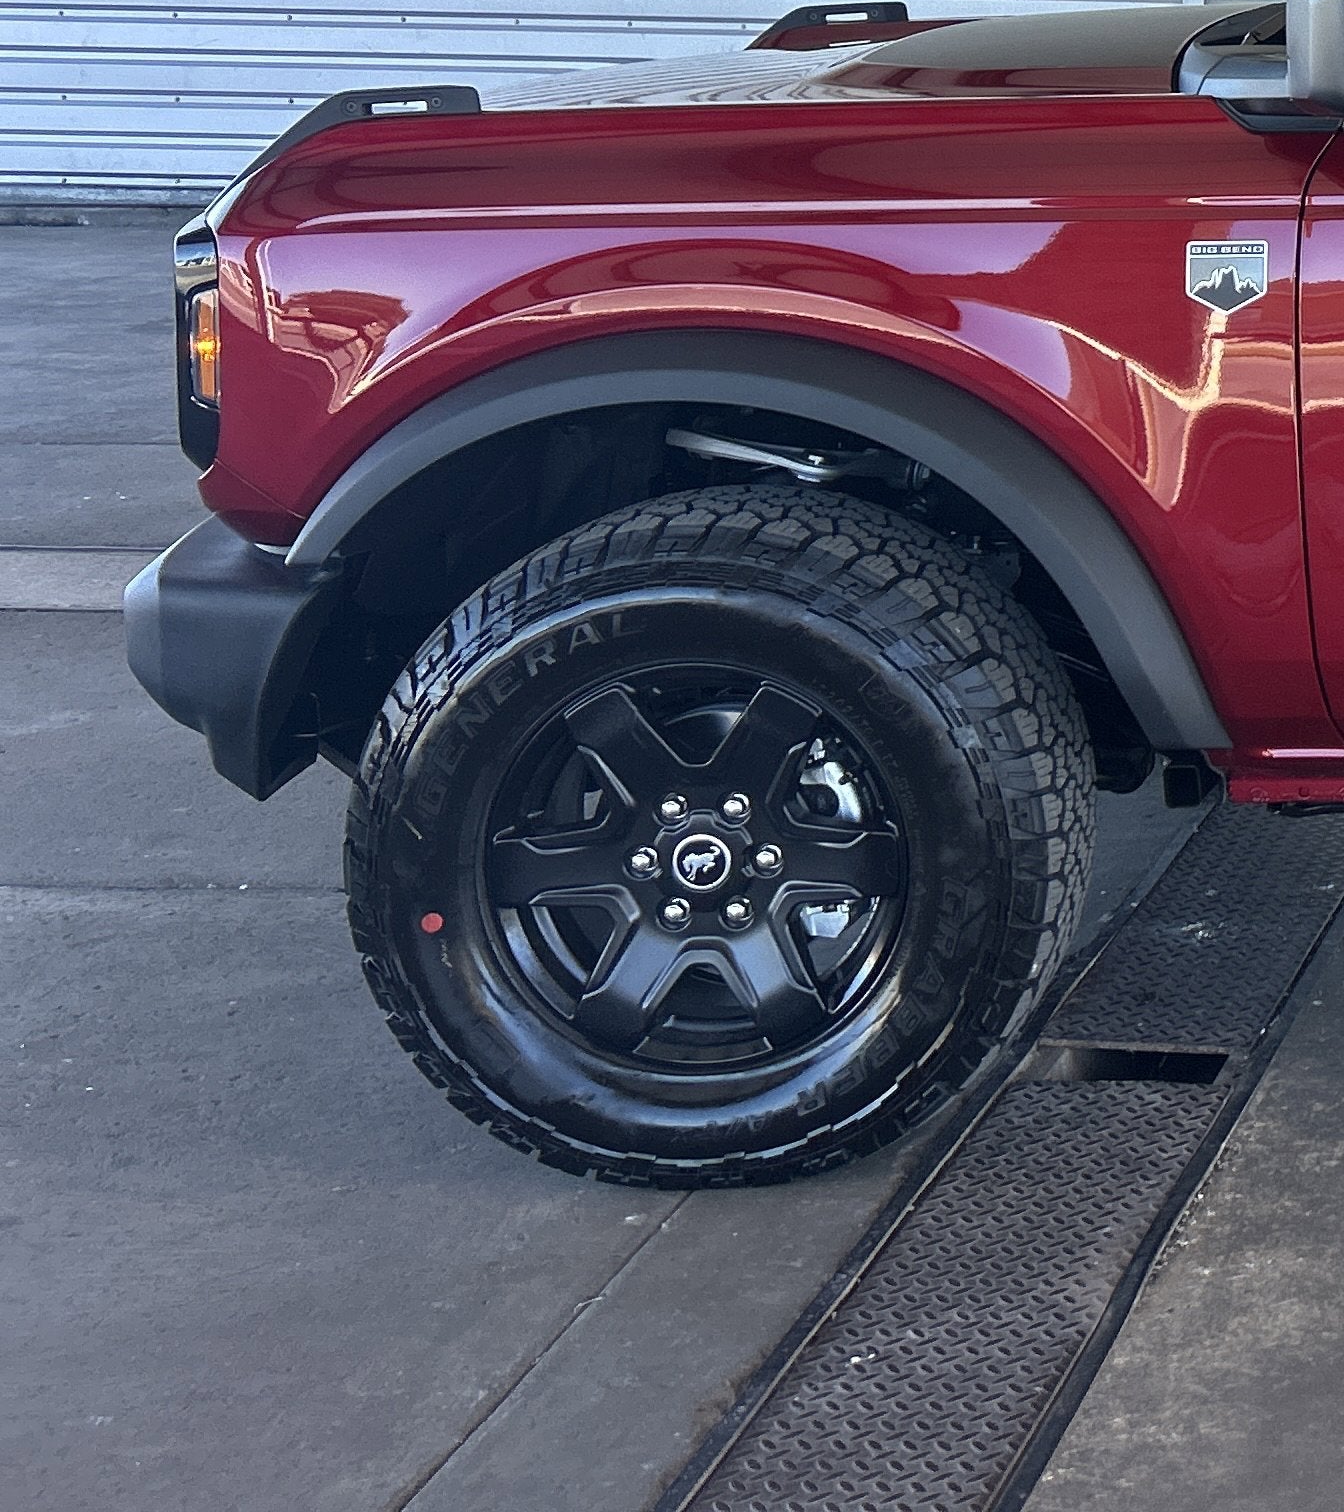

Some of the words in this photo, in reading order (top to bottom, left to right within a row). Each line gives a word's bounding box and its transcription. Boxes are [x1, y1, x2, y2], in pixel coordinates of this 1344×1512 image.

[1191, 245, 1218, 254] BIG
[1220, 244, 1264, 254] BEND
[415, 612, 646, 815] GENERAL
